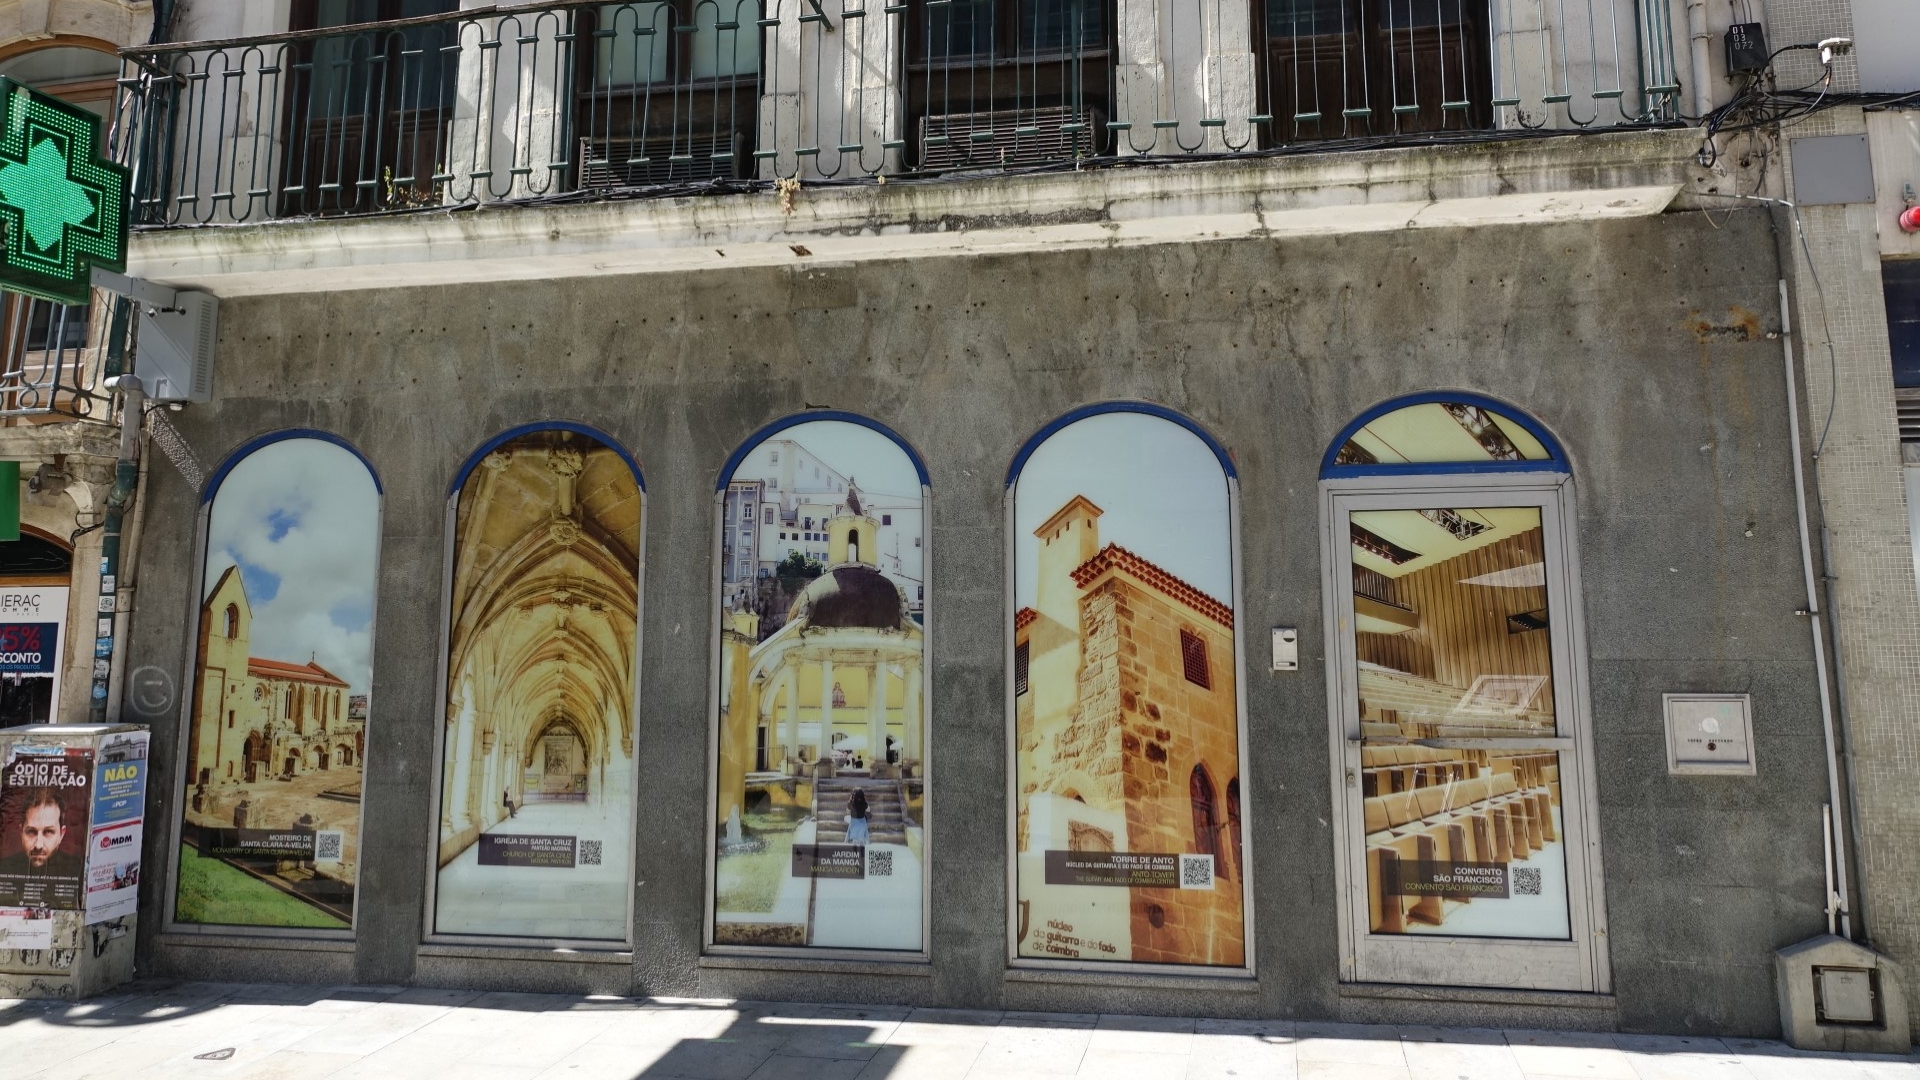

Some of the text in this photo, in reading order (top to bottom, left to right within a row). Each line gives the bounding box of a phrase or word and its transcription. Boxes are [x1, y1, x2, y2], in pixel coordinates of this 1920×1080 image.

[0, 625, 41, 652] 5%
[14, 760, 69, 777] ÓDIO DE
[104, 764, 138, 782] NÃO
[9, 770, 87, 790] ESTIMAÇÃO
[116, 800, 128, 808] PCP
[111, 835, 132, 846] MDM
[269, 834, 301, 842] MOSTEIRO
[494, 837, 518, 846] IGREJA
[519, 838, 529, 846] DE
[261, 841, 312, 849] CLARA-A-VELHA
[502, 850, 527, 859] CHURCH
[527, 852, 536, 860] OF
[536, 852, 555, 860] SANTA
[832, 850, 860, 859] JARDIM
[832, 858, 860, 866] MANGA
[1066, 860, 1085, 868] NÚCLEO
[1111, 855, 1175, 865] TORRE DE ANTO
[1152, 871, 1175, 879] TOWER
[1454, 867, 1502, 876] CONVENTO
[1433, 873, 1502, 884] SÃO FRANCISCO
[1404, 882, 1504, 893] CONVENTO SÃO FRANCISCO
[1047, 919, 1073, 932] núcleo
[1046, 932, 1080, 946] guitarra
[1080, 939, 1086, 948] e
[1098, 940, 1116, 954] fado
[1032, 941, 1080, 958] de coimbra
